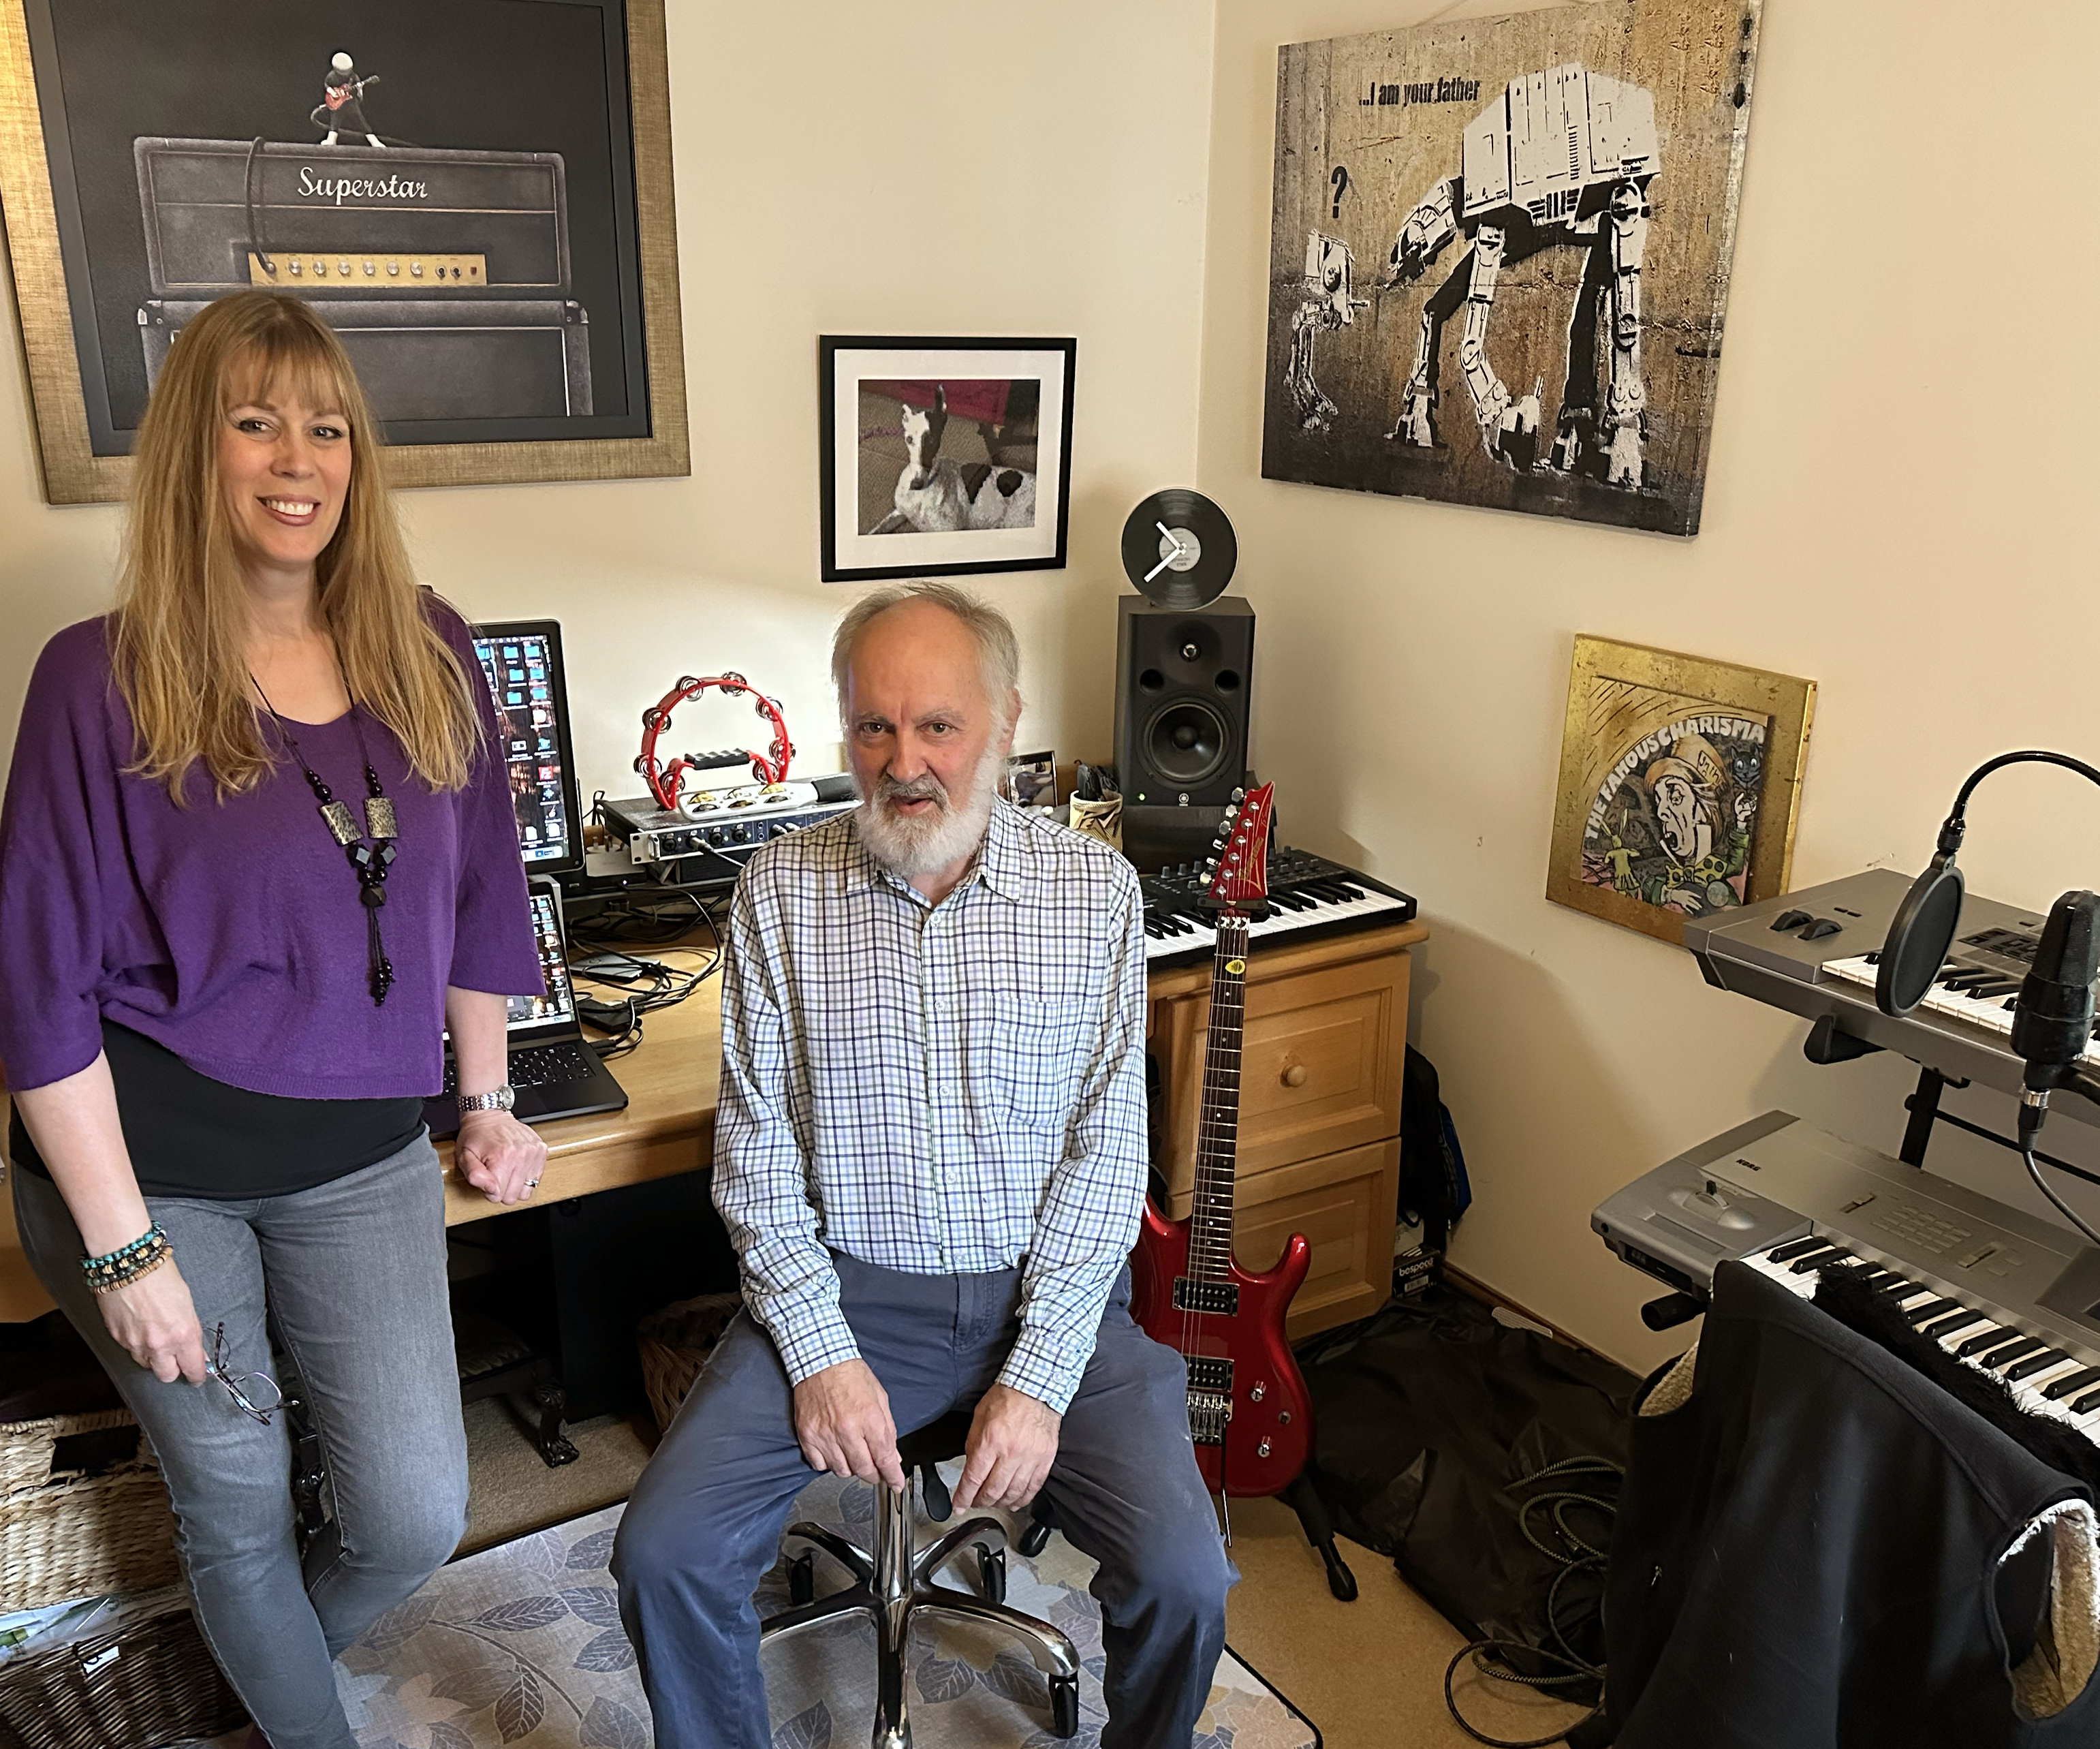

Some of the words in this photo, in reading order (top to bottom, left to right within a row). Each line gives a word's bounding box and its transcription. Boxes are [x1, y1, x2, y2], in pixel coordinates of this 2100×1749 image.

[1378, 84, 1399, 105] am
[1403, 82, 1434, 107] your
[1435, 76, 1480, 103] father
[297, 166, 428, 206] Superstar
[1585, 796, 1608, 839] THE
[1601, 733, 1659, 802] FAMOUS
[1657, 716, 1766, 747] CHARISMA
